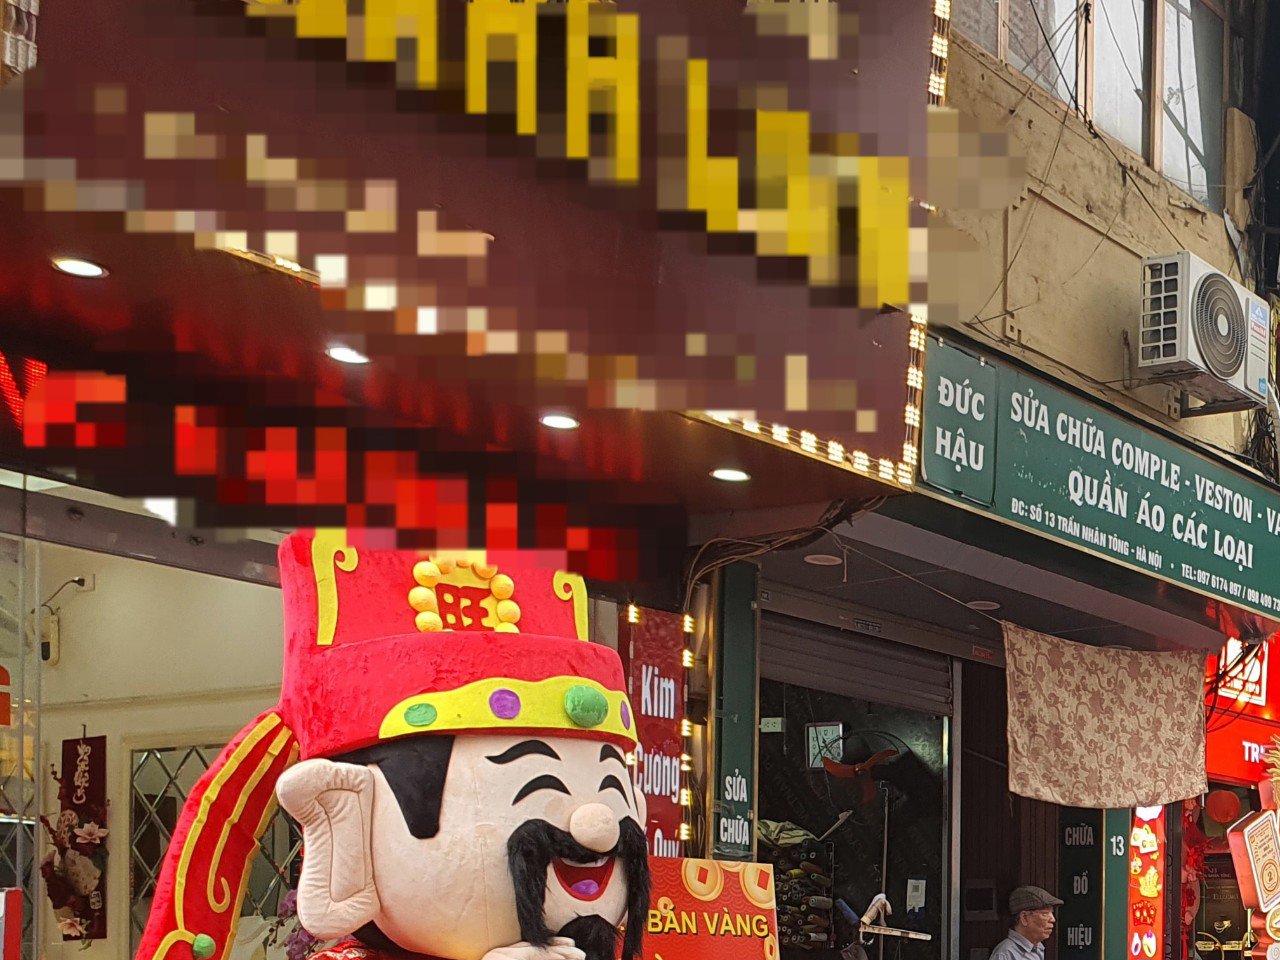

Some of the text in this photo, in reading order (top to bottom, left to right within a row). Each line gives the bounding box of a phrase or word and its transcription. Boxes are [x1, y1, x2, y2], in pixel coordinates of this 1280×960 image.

[938, 375, 985, 421] ĐỨC
[935, 426, 985, 473] HẬU
[1011, 388, 1050, 436] SỬA
[1056, 412, 1106, 460] CHỮA
[1111, 437, 1181, 492] COMPLE
[1194, 473, 1253, 524] VESTON
[1068, 468, 1254, 572] QUẦN ÁO CÁC LOẠI
[1011, 497, 1028, 517] ĐC:
[1029, 503, 1043, 523] SỐ
[1044, 510, 1055, 528] 13
[1081, 525, 1107, 548] NHÂN
[1108, 530, 1130, 556] TÔNG
[1136, 544, 1147, 563] HÀ
[1148, 550, 1163, 571] NỘI
[1211, 574, 1228, 592] 6174
[641, 664, 675, 719] Kim
[634, 741, 680, 804] Cường
[725, 768, 747, 803] SỬA
[719, 814, 750, 846] CHỮA
[1064, 822, 1095, 846] CHỮA
[1110, 835, 1125, 856] 13
[1073, 870, 1089, 895] ĐỒ
[703, 907, 770, 938] VÀNG
[1067, 923, 1092, 949] HIỆU
